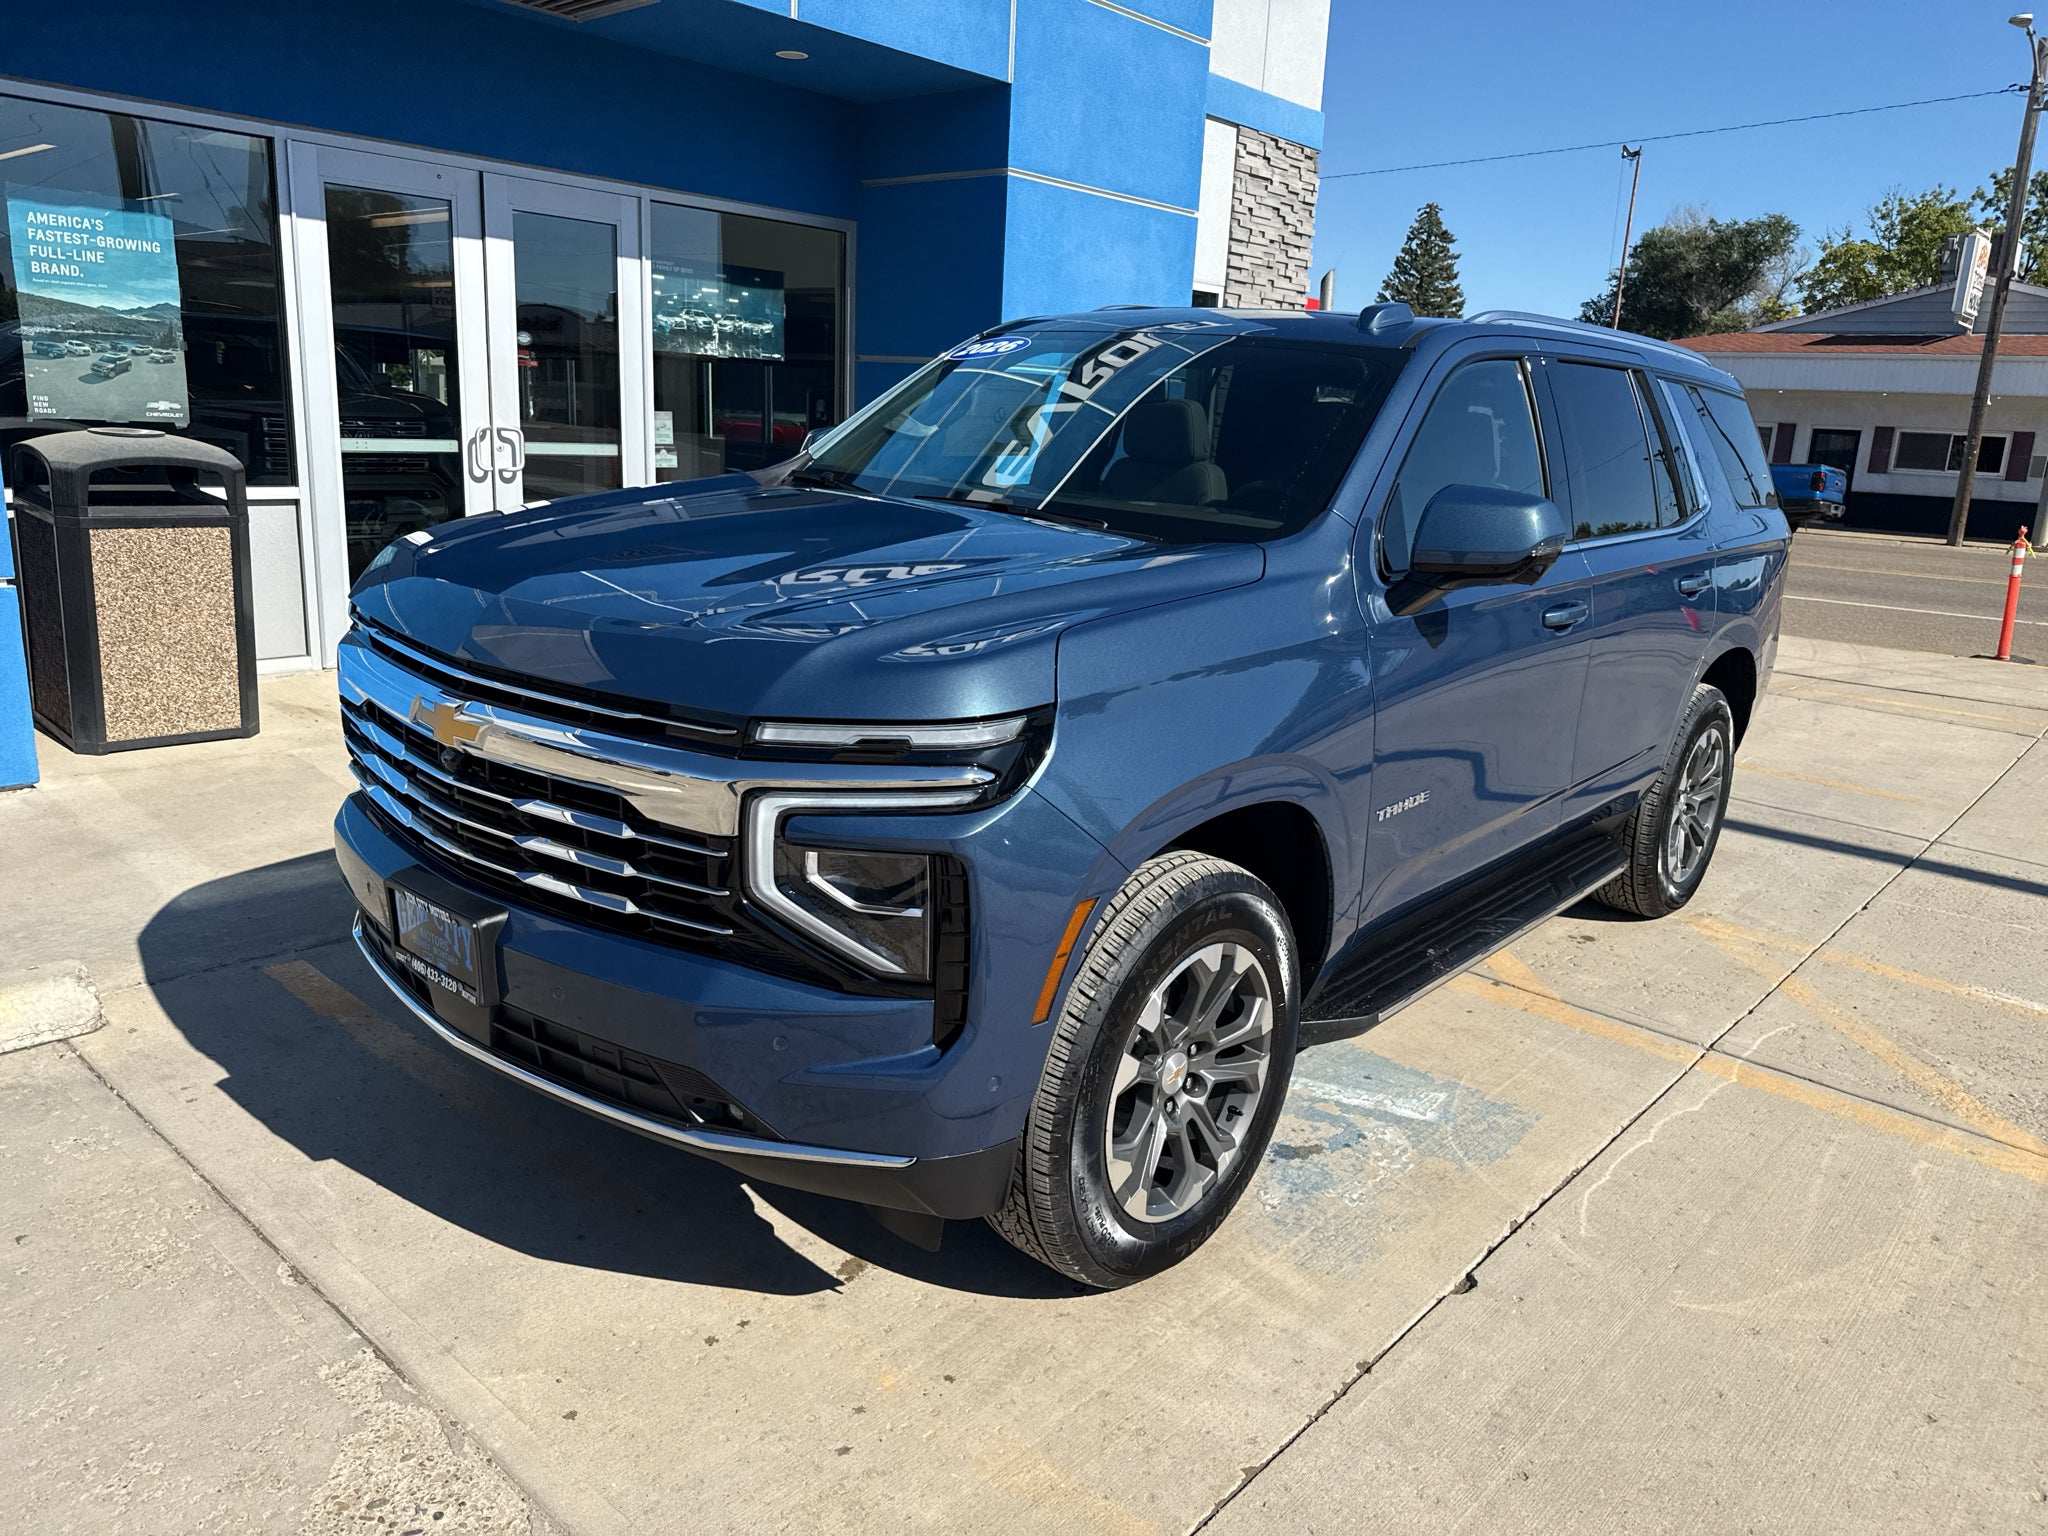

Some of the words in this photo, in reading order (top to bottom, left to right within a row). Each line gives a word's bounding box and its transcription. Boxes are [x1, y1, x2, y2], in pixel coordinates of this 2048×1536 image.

[27, 211, 104, 231] AMERICA'S
[27, 228, 161, 253] FASTEST-GROWING
[29, 244, 105, 264] FULL-LINE
[31, 261, 84, 278] BRAND.
[952, 340, 1025, 357] 2026
[1376, 790, 1431, 822] TAHOE
[420, 927, 449, 952] MOTORS
[411, 957, 427, 976] (406)
[426, 966, 457, 993] 433-3120
